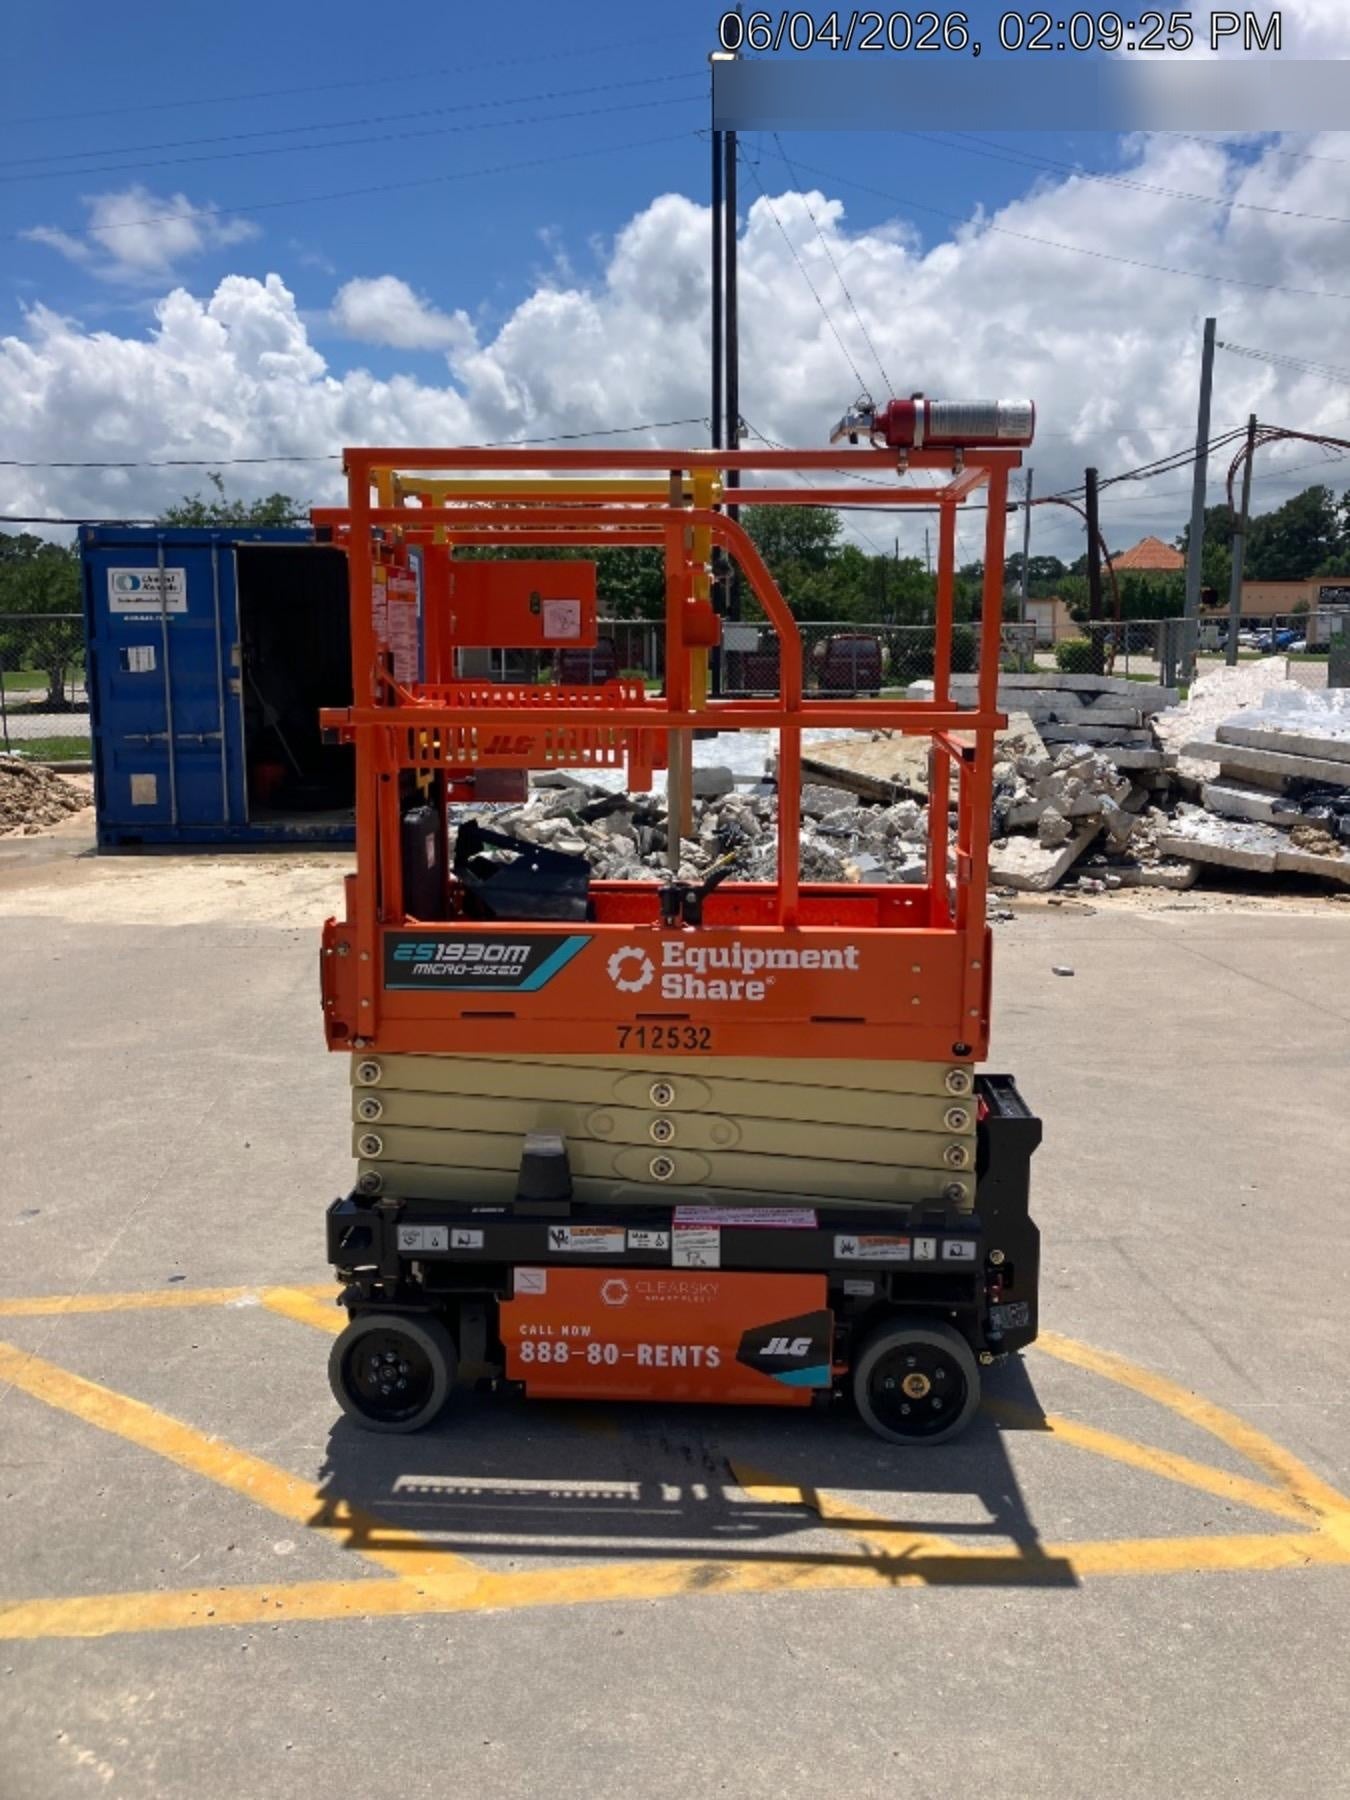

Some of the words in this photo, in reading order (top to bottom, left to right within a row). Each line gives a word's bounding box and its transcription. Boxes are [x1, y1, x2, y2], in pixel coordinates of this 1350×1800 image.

[484, 735, 533, 755] JLG
[393, 943, 532, 963] ES1930M
[661, 941, 860, 975] Equipment
[411, 963, 523, 976] MICRO-SIZED
[616, 1025, 712, 1050] 712532
[519, 1324, 554, 1336] CALL
[561, 1325, 592, 1337] NOW
[519, 1340, 721, 1368] 888-80-RENTS
[759, 1337, 813, 1357] JLG
